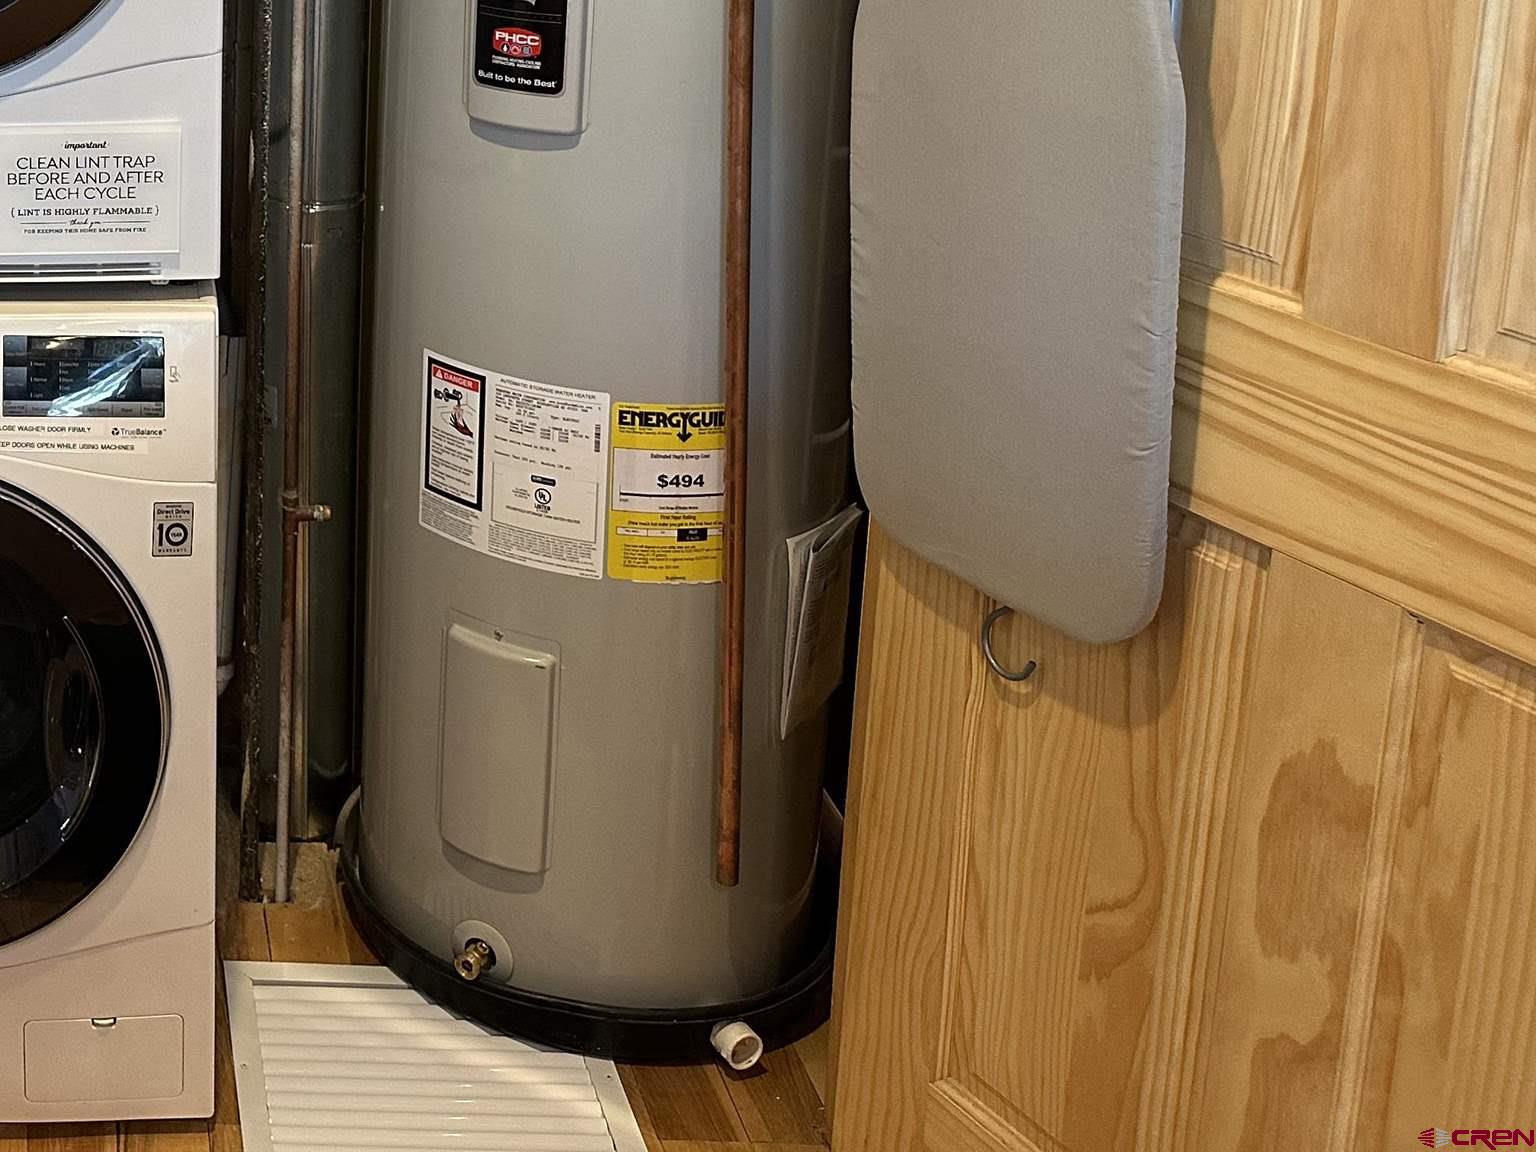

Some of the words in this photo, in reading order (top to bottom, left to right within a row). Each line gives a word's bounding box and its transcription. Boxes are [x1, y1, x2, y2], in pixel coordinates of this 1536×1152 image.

[495, 30, 540, 46] PHCC
[478, 69, 494, 80] Built
[495, 73, 503, 81] to
[505, 75, 516, 83] be
[517, 77, 532, 86] the
[534, 78, 556, 88] Best
[63, 140, 108, 151] important
[16, 156, 71, 170] CLEAN
[75, 155, 110, 169] LINT
[112, 155, 156, 169] TRAP
[7, 172, 70, 186] BEFORE
[73, 171, 111, 185] AND
[114, 170, 165, 184] AFTER
[34, 187, 79, 201] EACH
[83, 186, 137, 200] CYCLE
[17, 208, 41, 217] LINT
[42, 208, 52, 216] IS
[54, 208, 91, 216] HIGHLY
[92, 207, 153, 215] FLAMMABLE
[443, 371, 474, 389] DANGER
[500, 377, 528, 389] AUTOMATIC
[529, 384, 554, 394] STORAGE
[554, 389, 574, 397] WATER
[574, 392, 596, 400] HEATER
[618, 409, 726, 429] ENERGYGUID
[119, 427, 163, 436] TrueBalance
[11, 441, 36, 449] DOORS
[657, 473, 705, 489] $494
[157, 522, 189, 547] 10
